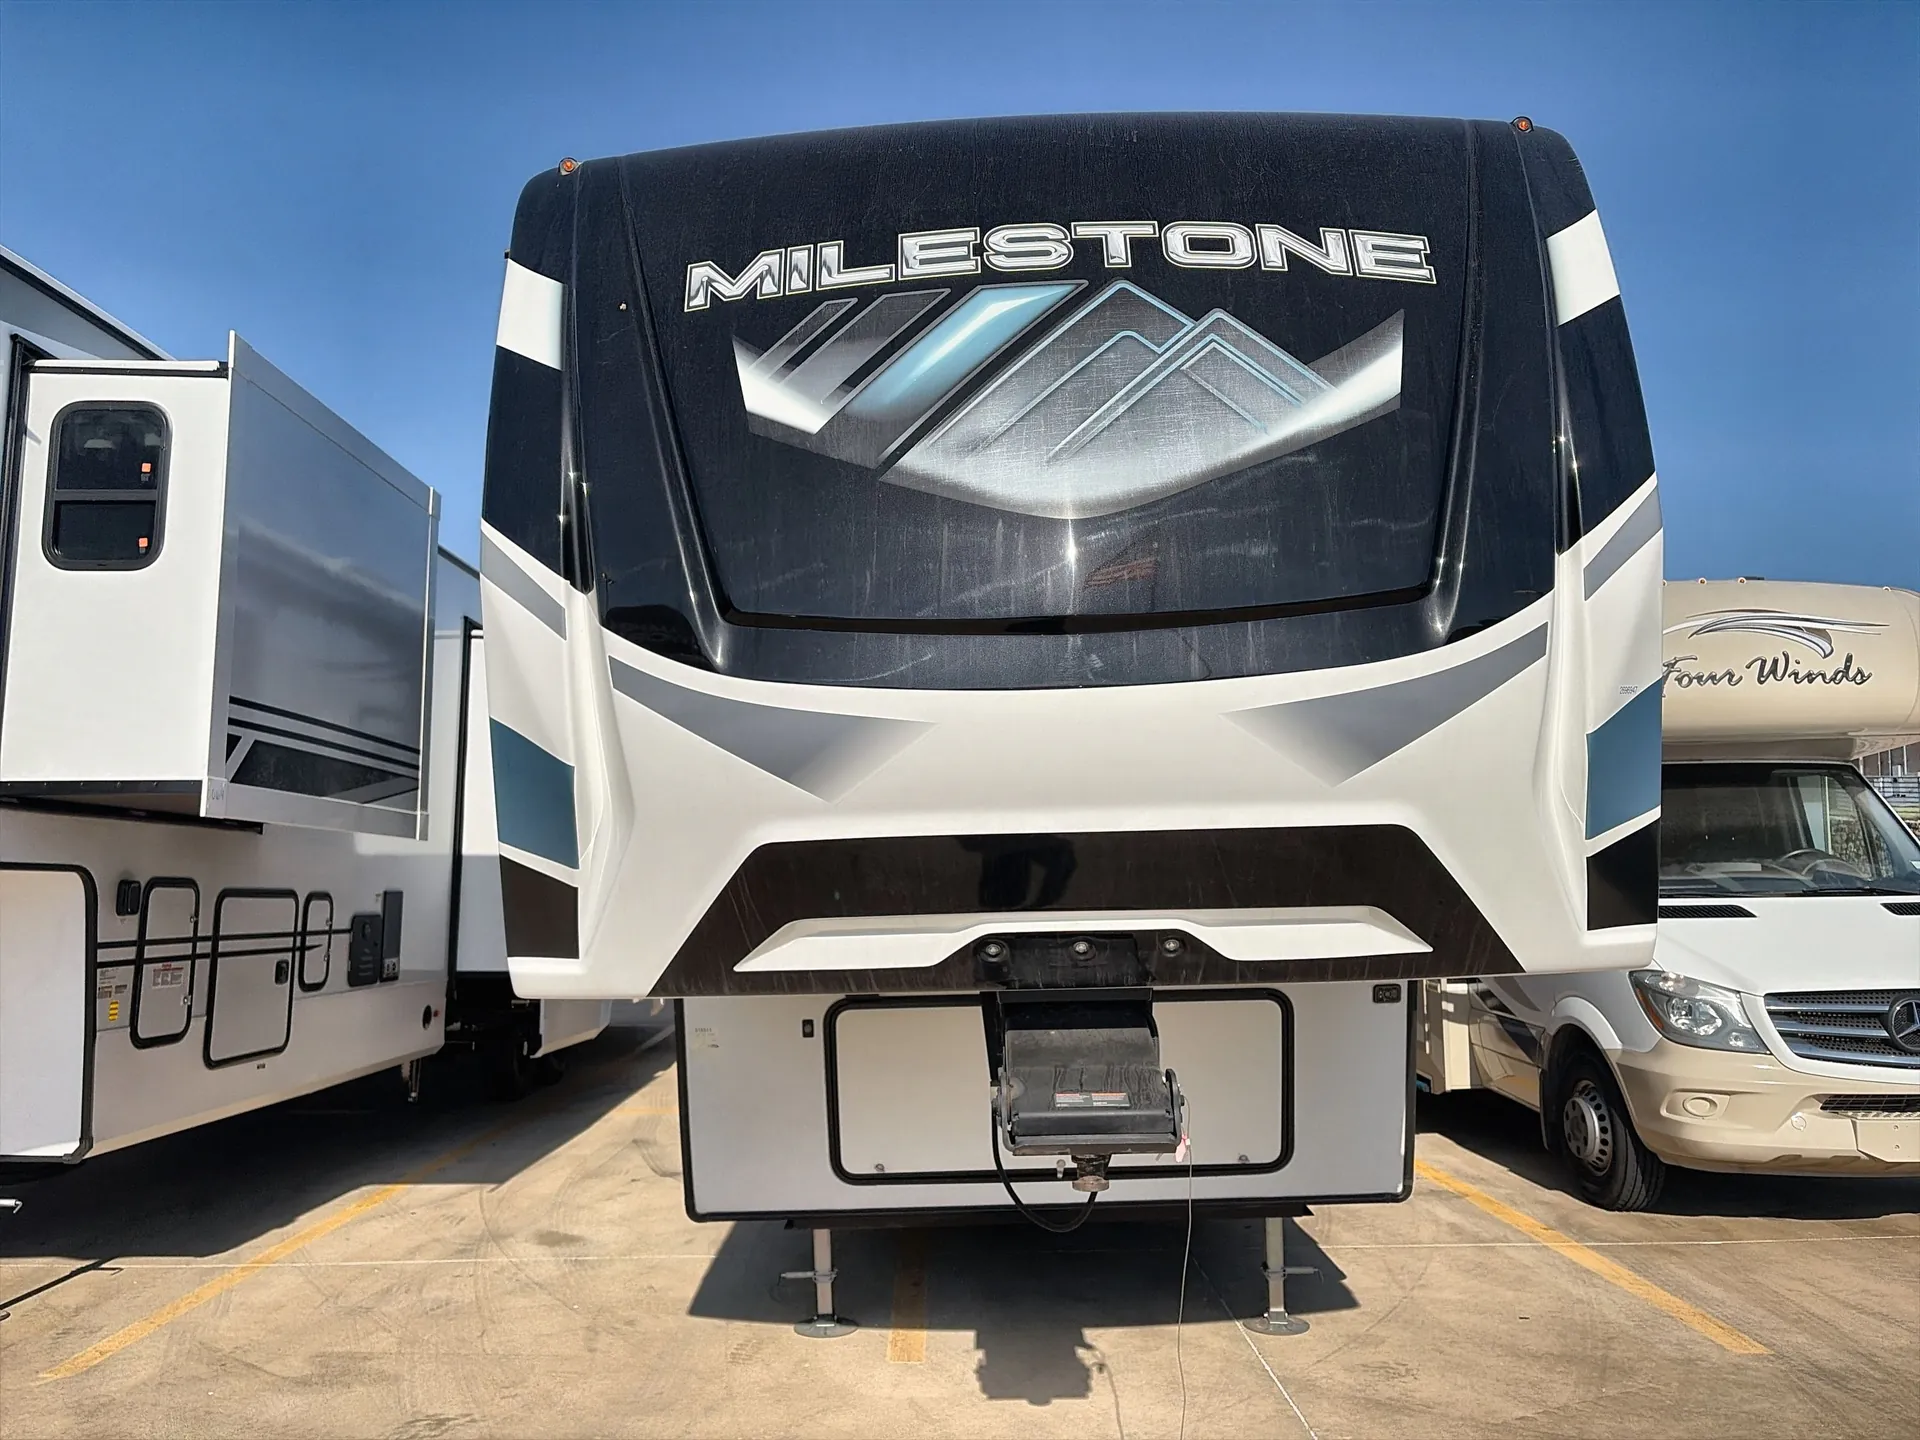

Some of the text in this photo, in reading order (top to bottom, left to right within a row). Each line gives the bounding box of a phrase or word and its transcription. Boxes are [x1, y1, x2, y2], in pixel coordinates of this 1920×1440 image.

[684, 221, 1437, 312] MILESTONE
[1662, 651, 1873, 697] Four Winds
